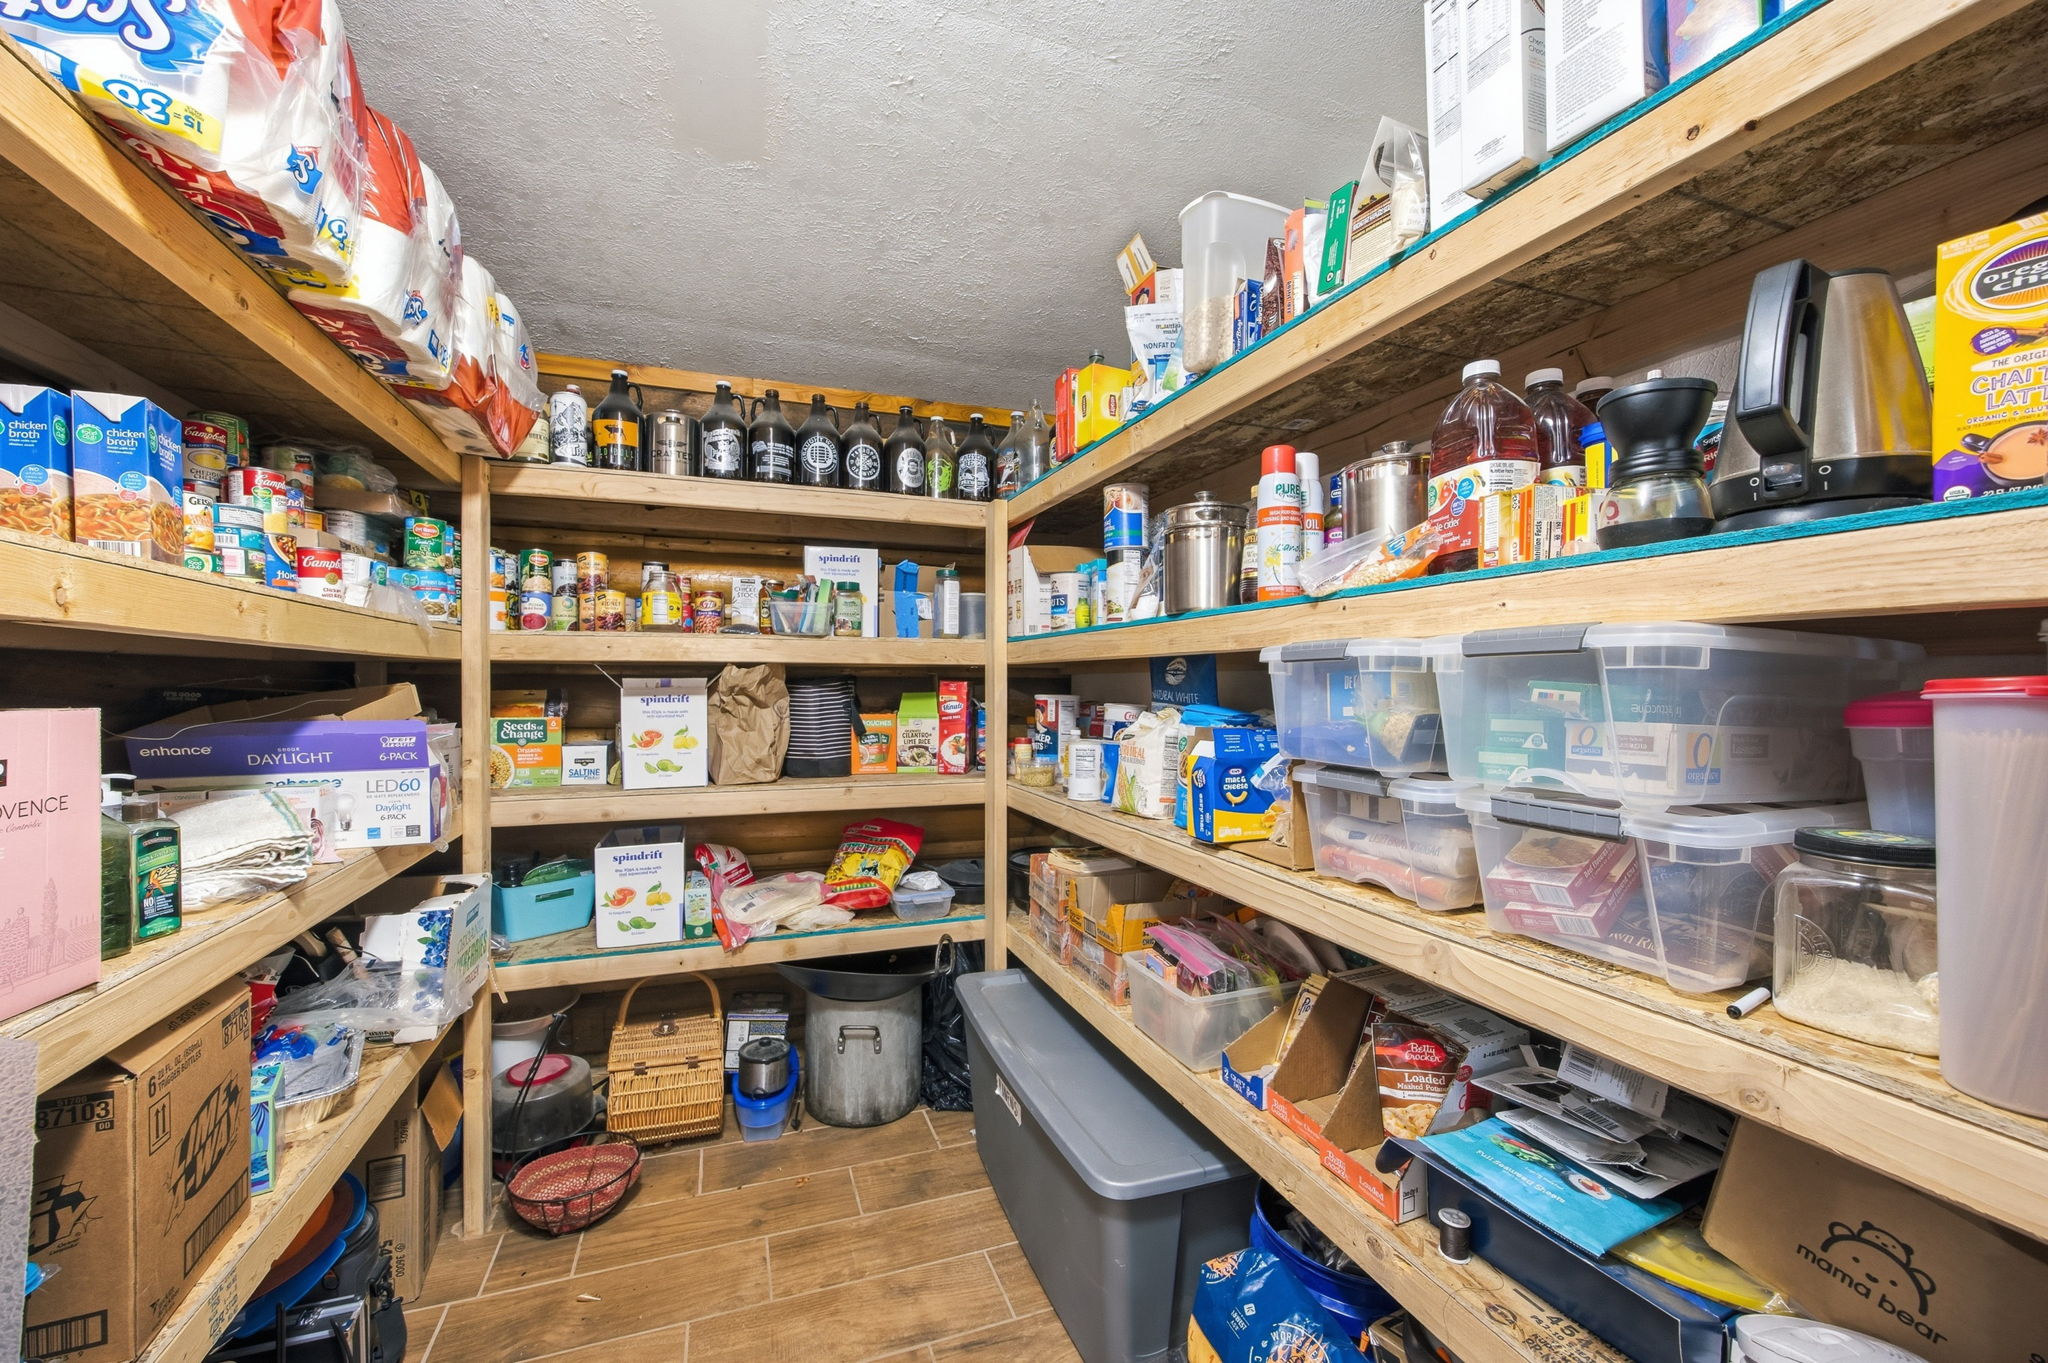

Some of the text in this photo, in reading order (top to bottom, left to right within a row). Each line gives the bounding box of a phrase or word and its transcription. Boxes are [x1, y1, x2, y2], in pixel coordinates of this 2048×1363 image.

[102, 79, 173, 125] 30
[183, 114, 203, 134] 15
[1144, 342, 1169, 350] NONFAT
[1992, 357, 2010, 368] THE
[1971, 367, 2031, 395] CHAI
[1967, 412, 2007, 424] ORGANIC
[9, 421, 47, 430] chicken
[9, 430, 40, 439] broth
[107, 429, 145, 439] chicken
[107, 438, 138, 447] broth
[159, 434, 181, 455] chicken
[651, 450, 692, 459] CRAFTED
[1306, 520, 1319, 529] OIL
[1443, 518, 1460, 530] cider
[819, 554, 861, 564] spindrift
[640, 694, 690, 706] spindrift
[1176, 692, 1200, 704] WHITE
[942, 702, 963, 711] Minute
[503, 721, 537, 731] Seeds
[500, 729, 544, 739] Change
[140, 746, 212, 757] enhance
[379, 751, 418, 761] 6-PACK
[247, 751, 333, 766] DAYLIGHT
[366, 778, 421, 794] LED60
[375, 803, 411, 812] Daylight
[380, 813, 406, 821] 6-PACK
[612, 850, 663, 864] spindrift
[143, 897, 154, 907] NO
[223, 1009, 249, 1045] 87103
[1408, 1043, 1435, 1054] Betty
[1405, 1051, 1442, 1062] Crocker
[158, 1050, 202, 1091] TRIGGER BOTTLES
[1224, 1068, 1229, 1081] 2
[1405, 1073, 1446, 1084] Loaded
[148, 1076, 157, 1098] 6
[1398, 1082, 1423, 1090] Mashed
[36, 1100, 111, 1129] 87103
[1476, 1149, 1493, 1162] Full
[1492, 1158, 1534, 1186] Seaweed
[1533, 1183, 1566, 1204] Sheets
[1358, 1176, 1384, 1200] Loaded
[1796, 1243, 1948, 1345] mama bear
